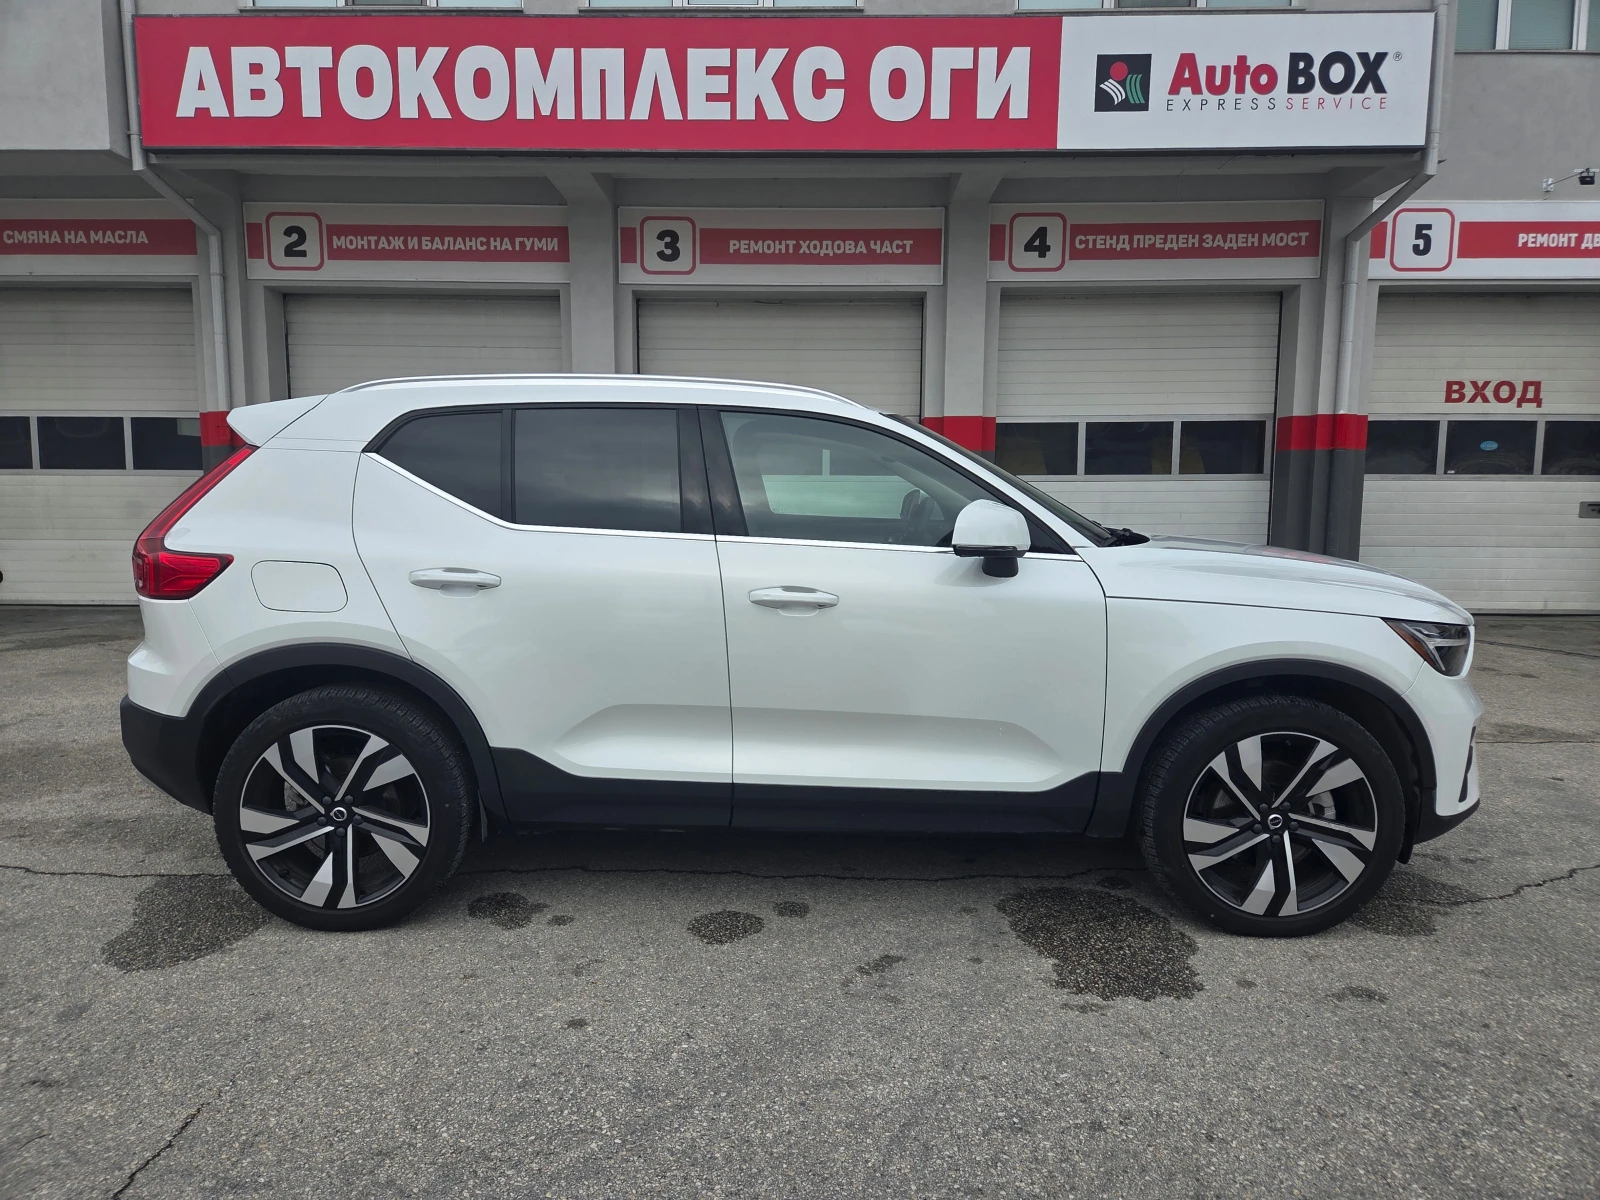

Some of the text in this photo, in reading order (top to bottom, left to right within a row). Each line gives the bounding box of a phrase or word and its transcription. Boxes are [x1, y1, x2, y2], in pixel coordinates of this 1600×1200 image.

[175, 44, 1031, 122] АВТОКОМПЛЕКС ОГИ
[1168, 51, 1389, 95] Auto BOX
[1166, 97, 1388, 111] EXPRESS SERVICE
[2, 230, 149, 244] СМЯНА НА МАСЛА
[283, 225, 308, 258] 2
[332, 236, 559, 252] МОНТАЖ И БАЛАНС НА ГУМИ
[656, 230, 680, 262] 3
[729, 240, 913, 257] РЕМОНТ ХОДОВА ЧАСТ
[1024, 227, 1051, 258] 4
[1075, 232, 1309, 251] СТЕНД ПРЕДЕН ЗАДЕН МОСТ
[1412, 224, 1432, 256] 5
[1518, 233, 1578, 247] РЕМОНТ
[1444, 380, 1543, 408] ВХОД
